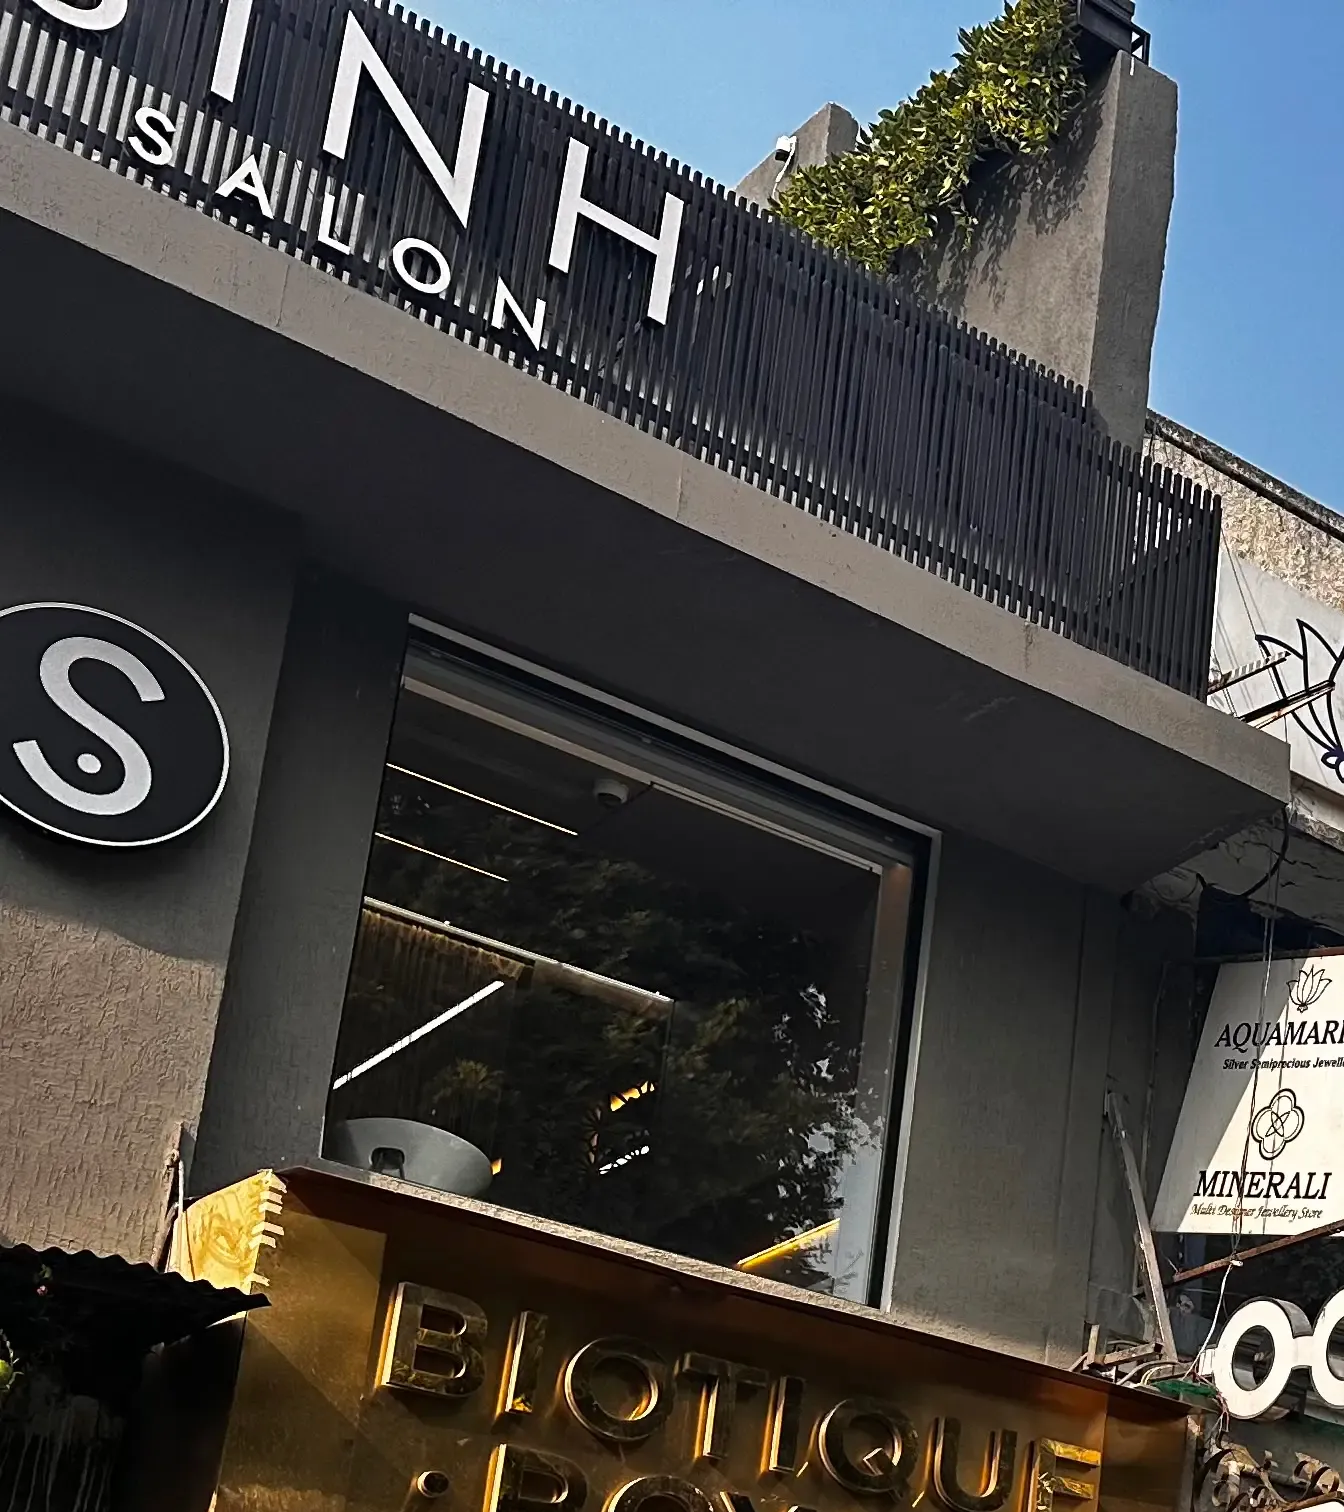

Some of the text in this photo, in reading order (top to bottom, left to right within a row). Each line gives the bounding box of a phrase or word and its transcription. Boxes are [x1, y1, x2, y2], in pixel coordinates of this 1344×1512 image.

[0, 0, 684, 325] INH
[129, 106, 547, 351] SALON
[1222, 1058, 1249, 1071] Silver
[1249, 1057, 1311, 1072] Semiprecious
[1192, 1170, 1333, 1200] MINERALI
